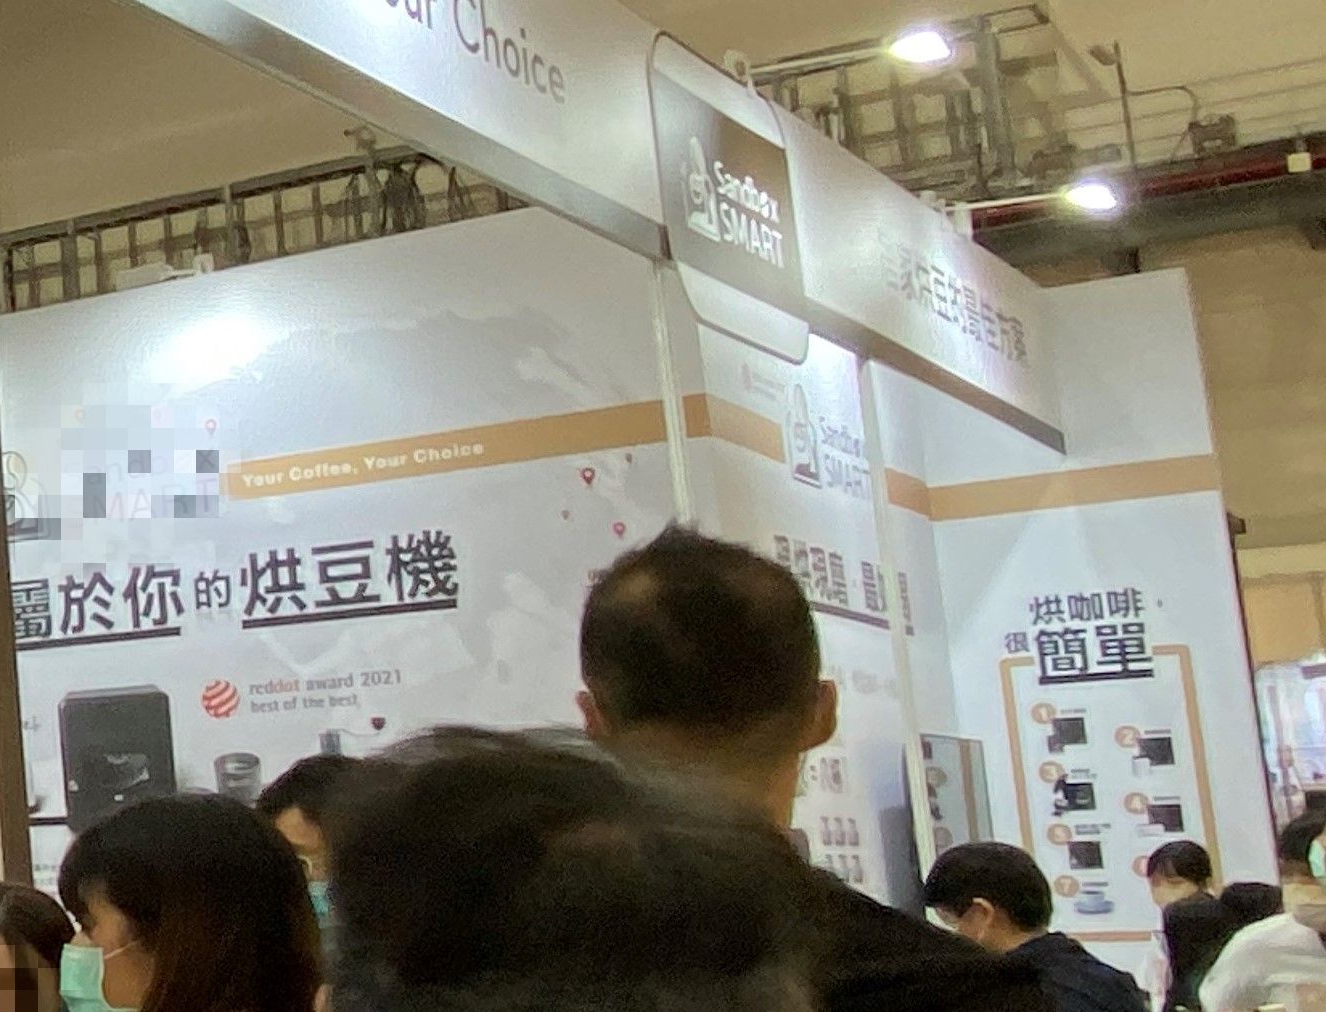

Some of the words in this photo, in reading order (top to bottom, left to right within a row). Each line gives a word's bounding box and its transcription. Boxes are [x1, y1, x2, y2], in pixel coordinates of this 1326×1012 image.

[453, 0, 566, 104] Choice
[713, 160, 780, 225] Sandbox
[719, 201, 785, 269] SMART
[241, 470, 284, 488] Your
[363, 453, 409, 471] Your
[412, 441, 485, 464] Choice
[250, 698, 280, 714] best
[282, 696, 297, 711] of
[305, 673, 354, 691] award
[359, 668, 402, 687] 2021
